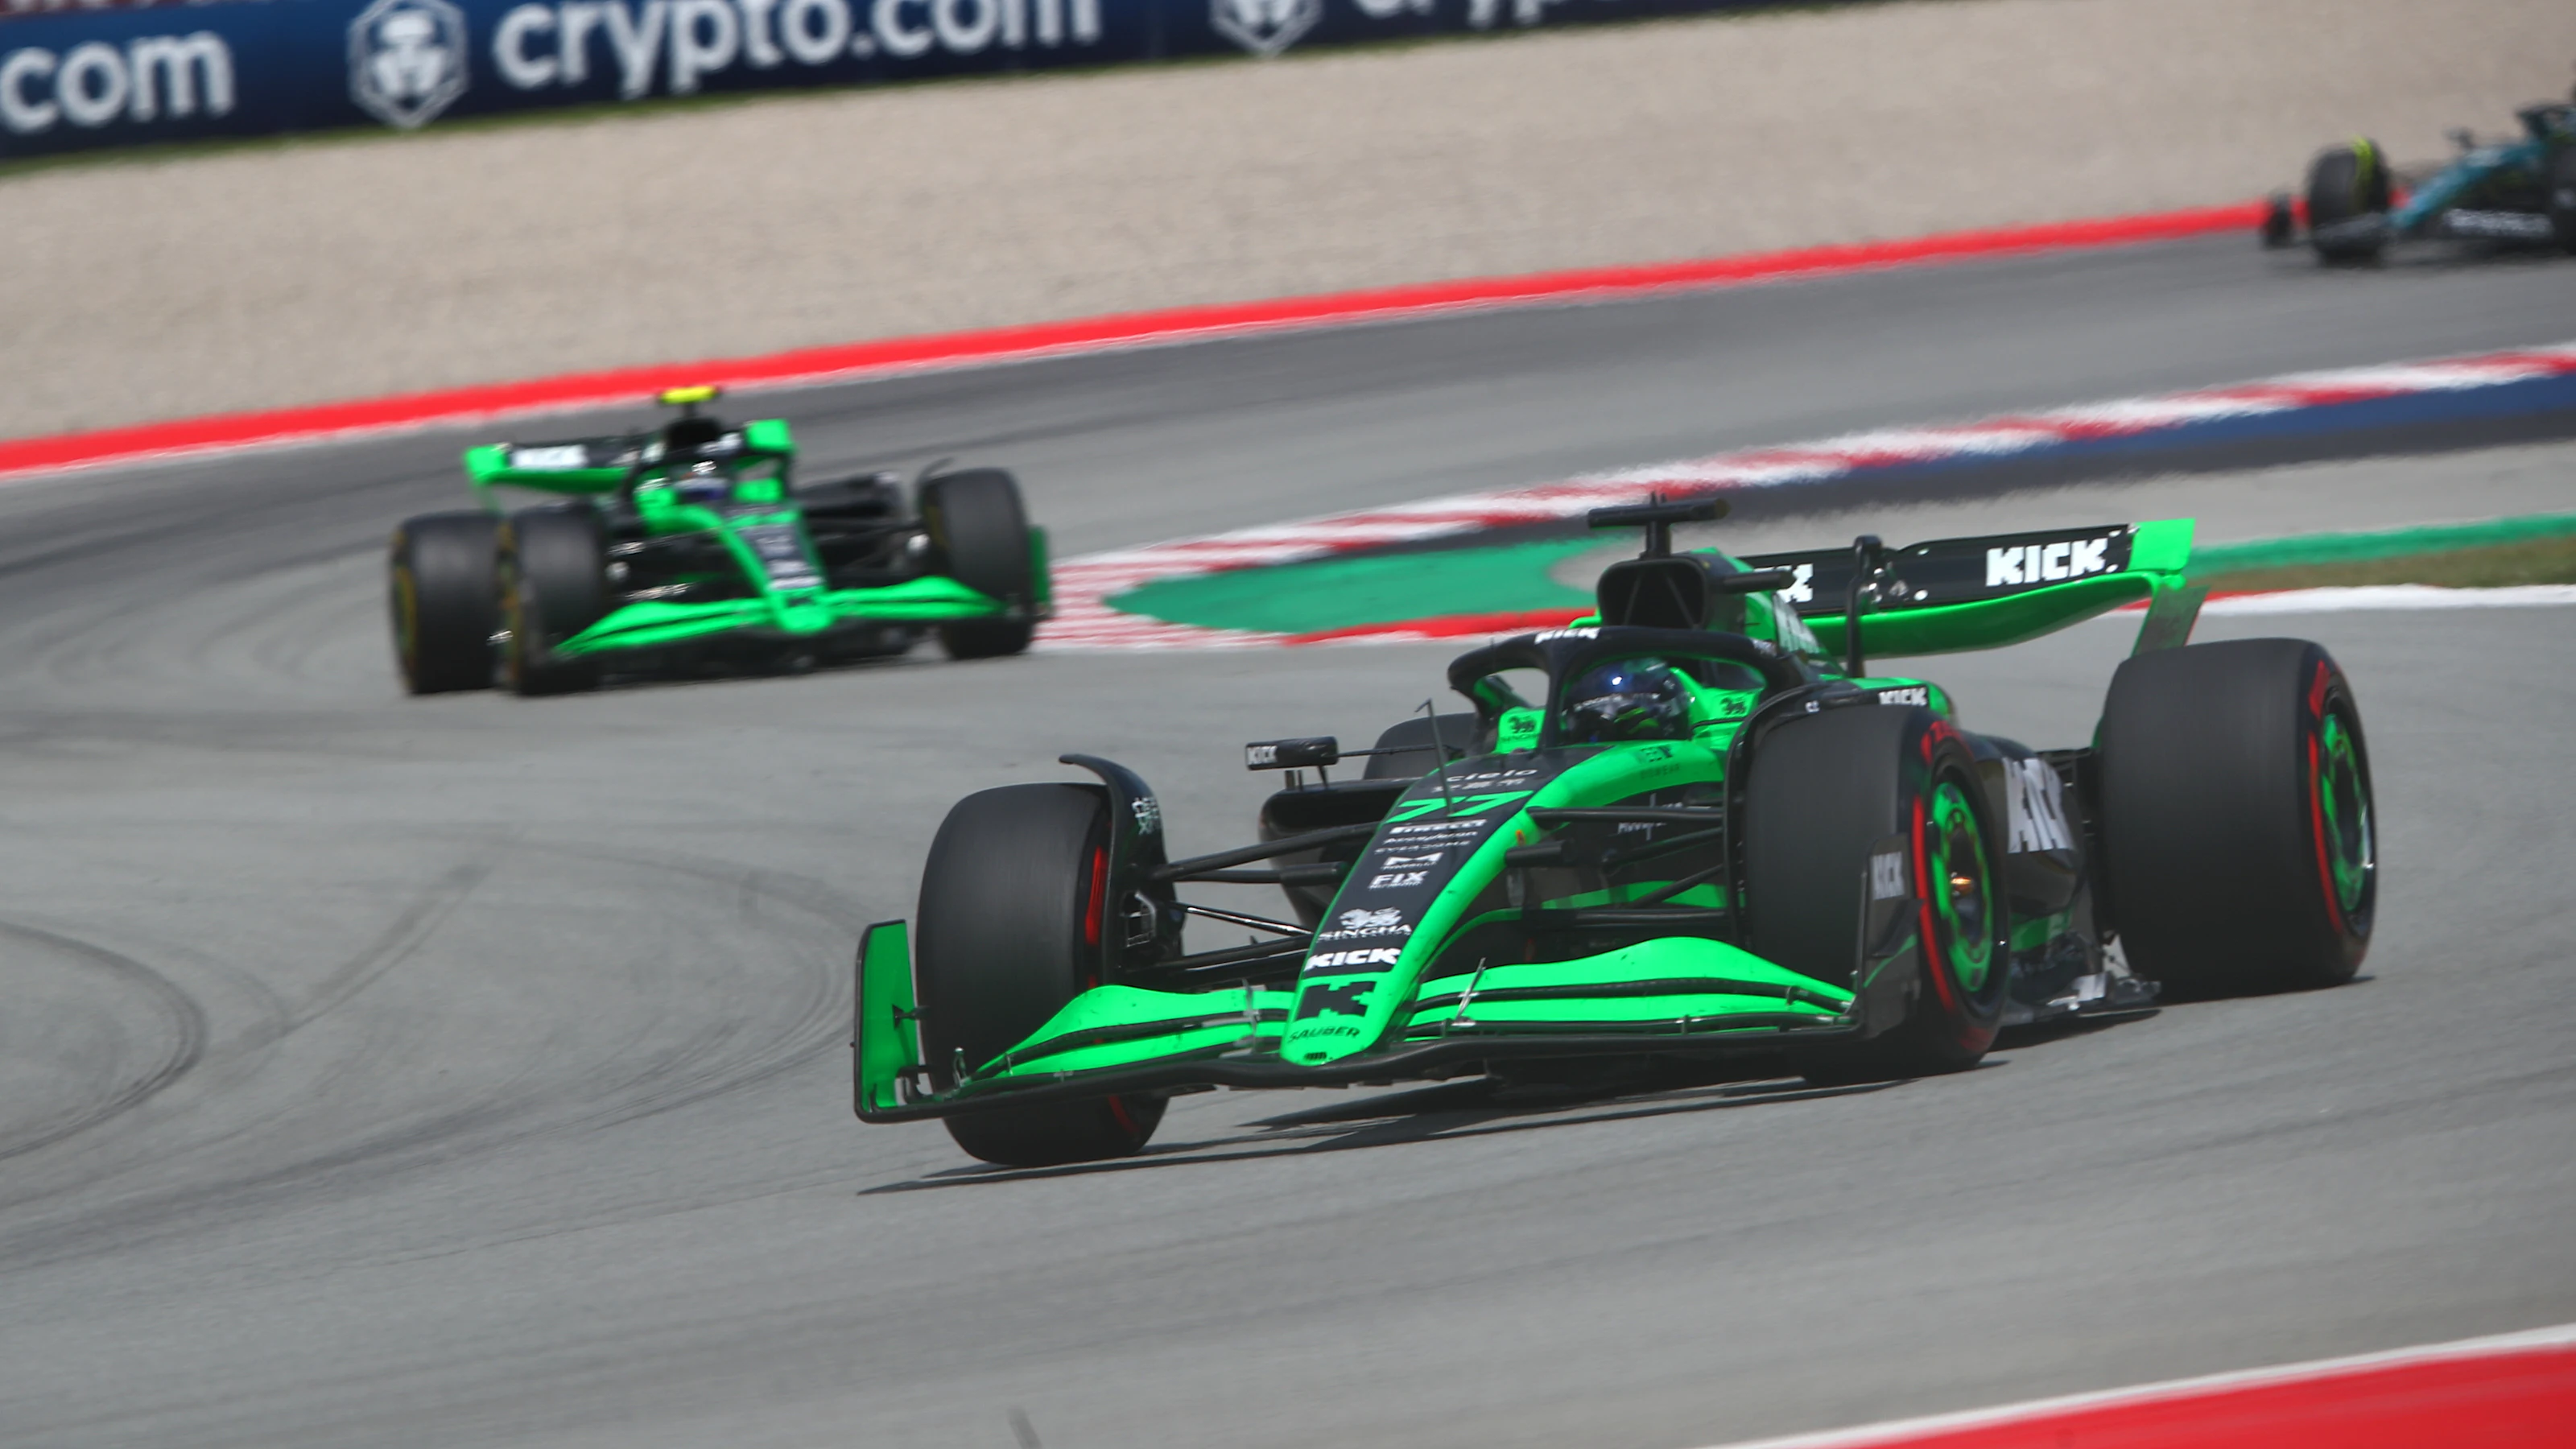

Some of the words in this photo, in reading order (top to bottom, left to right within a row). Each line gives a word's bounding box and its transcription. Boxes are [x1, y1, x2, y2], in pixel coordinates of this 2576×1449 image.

[0, 31, 236, 134] com
[1986, 538, 2108, 587] KICK
[1879, 687, 1927, 706] KICK
[1247, 745, 1278, 765] KICK
[1447, 770, 1538, 782] cielo
[1385, 791, 1534, 824] 77
[1389, 819, 1487, 834] PIRELLI
[1372, 870, 1429, 886] FIX
[1316, 924, 1413, 941] SINGHA
[1303, 947, 1402, 972] KICK
[1296, 980, 1377, 1022] K
[1288, 1026, 1360, 1043] SAUBER
